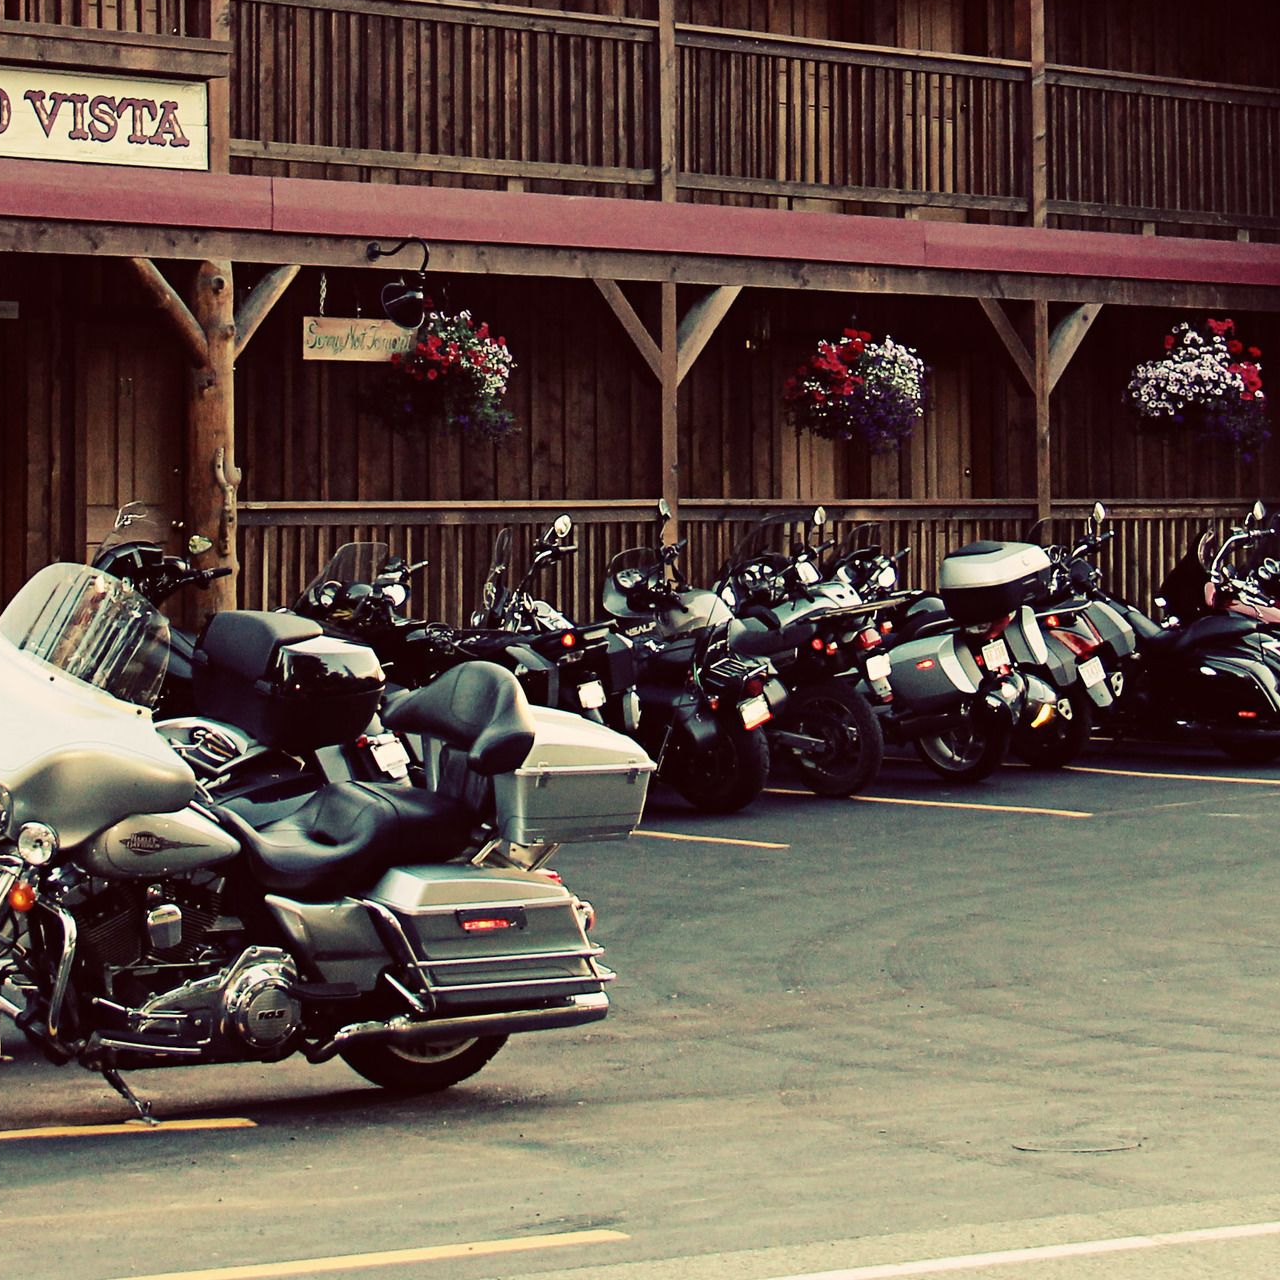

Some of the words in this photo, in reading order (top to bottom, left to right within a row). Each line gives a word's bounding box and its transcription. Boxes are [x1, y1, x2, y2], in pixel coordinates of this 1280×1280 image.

[24, 90, 190, 147] VISTA
[306, 320, 341, 354] Sorry
[341, 324, 368, 351] Not
